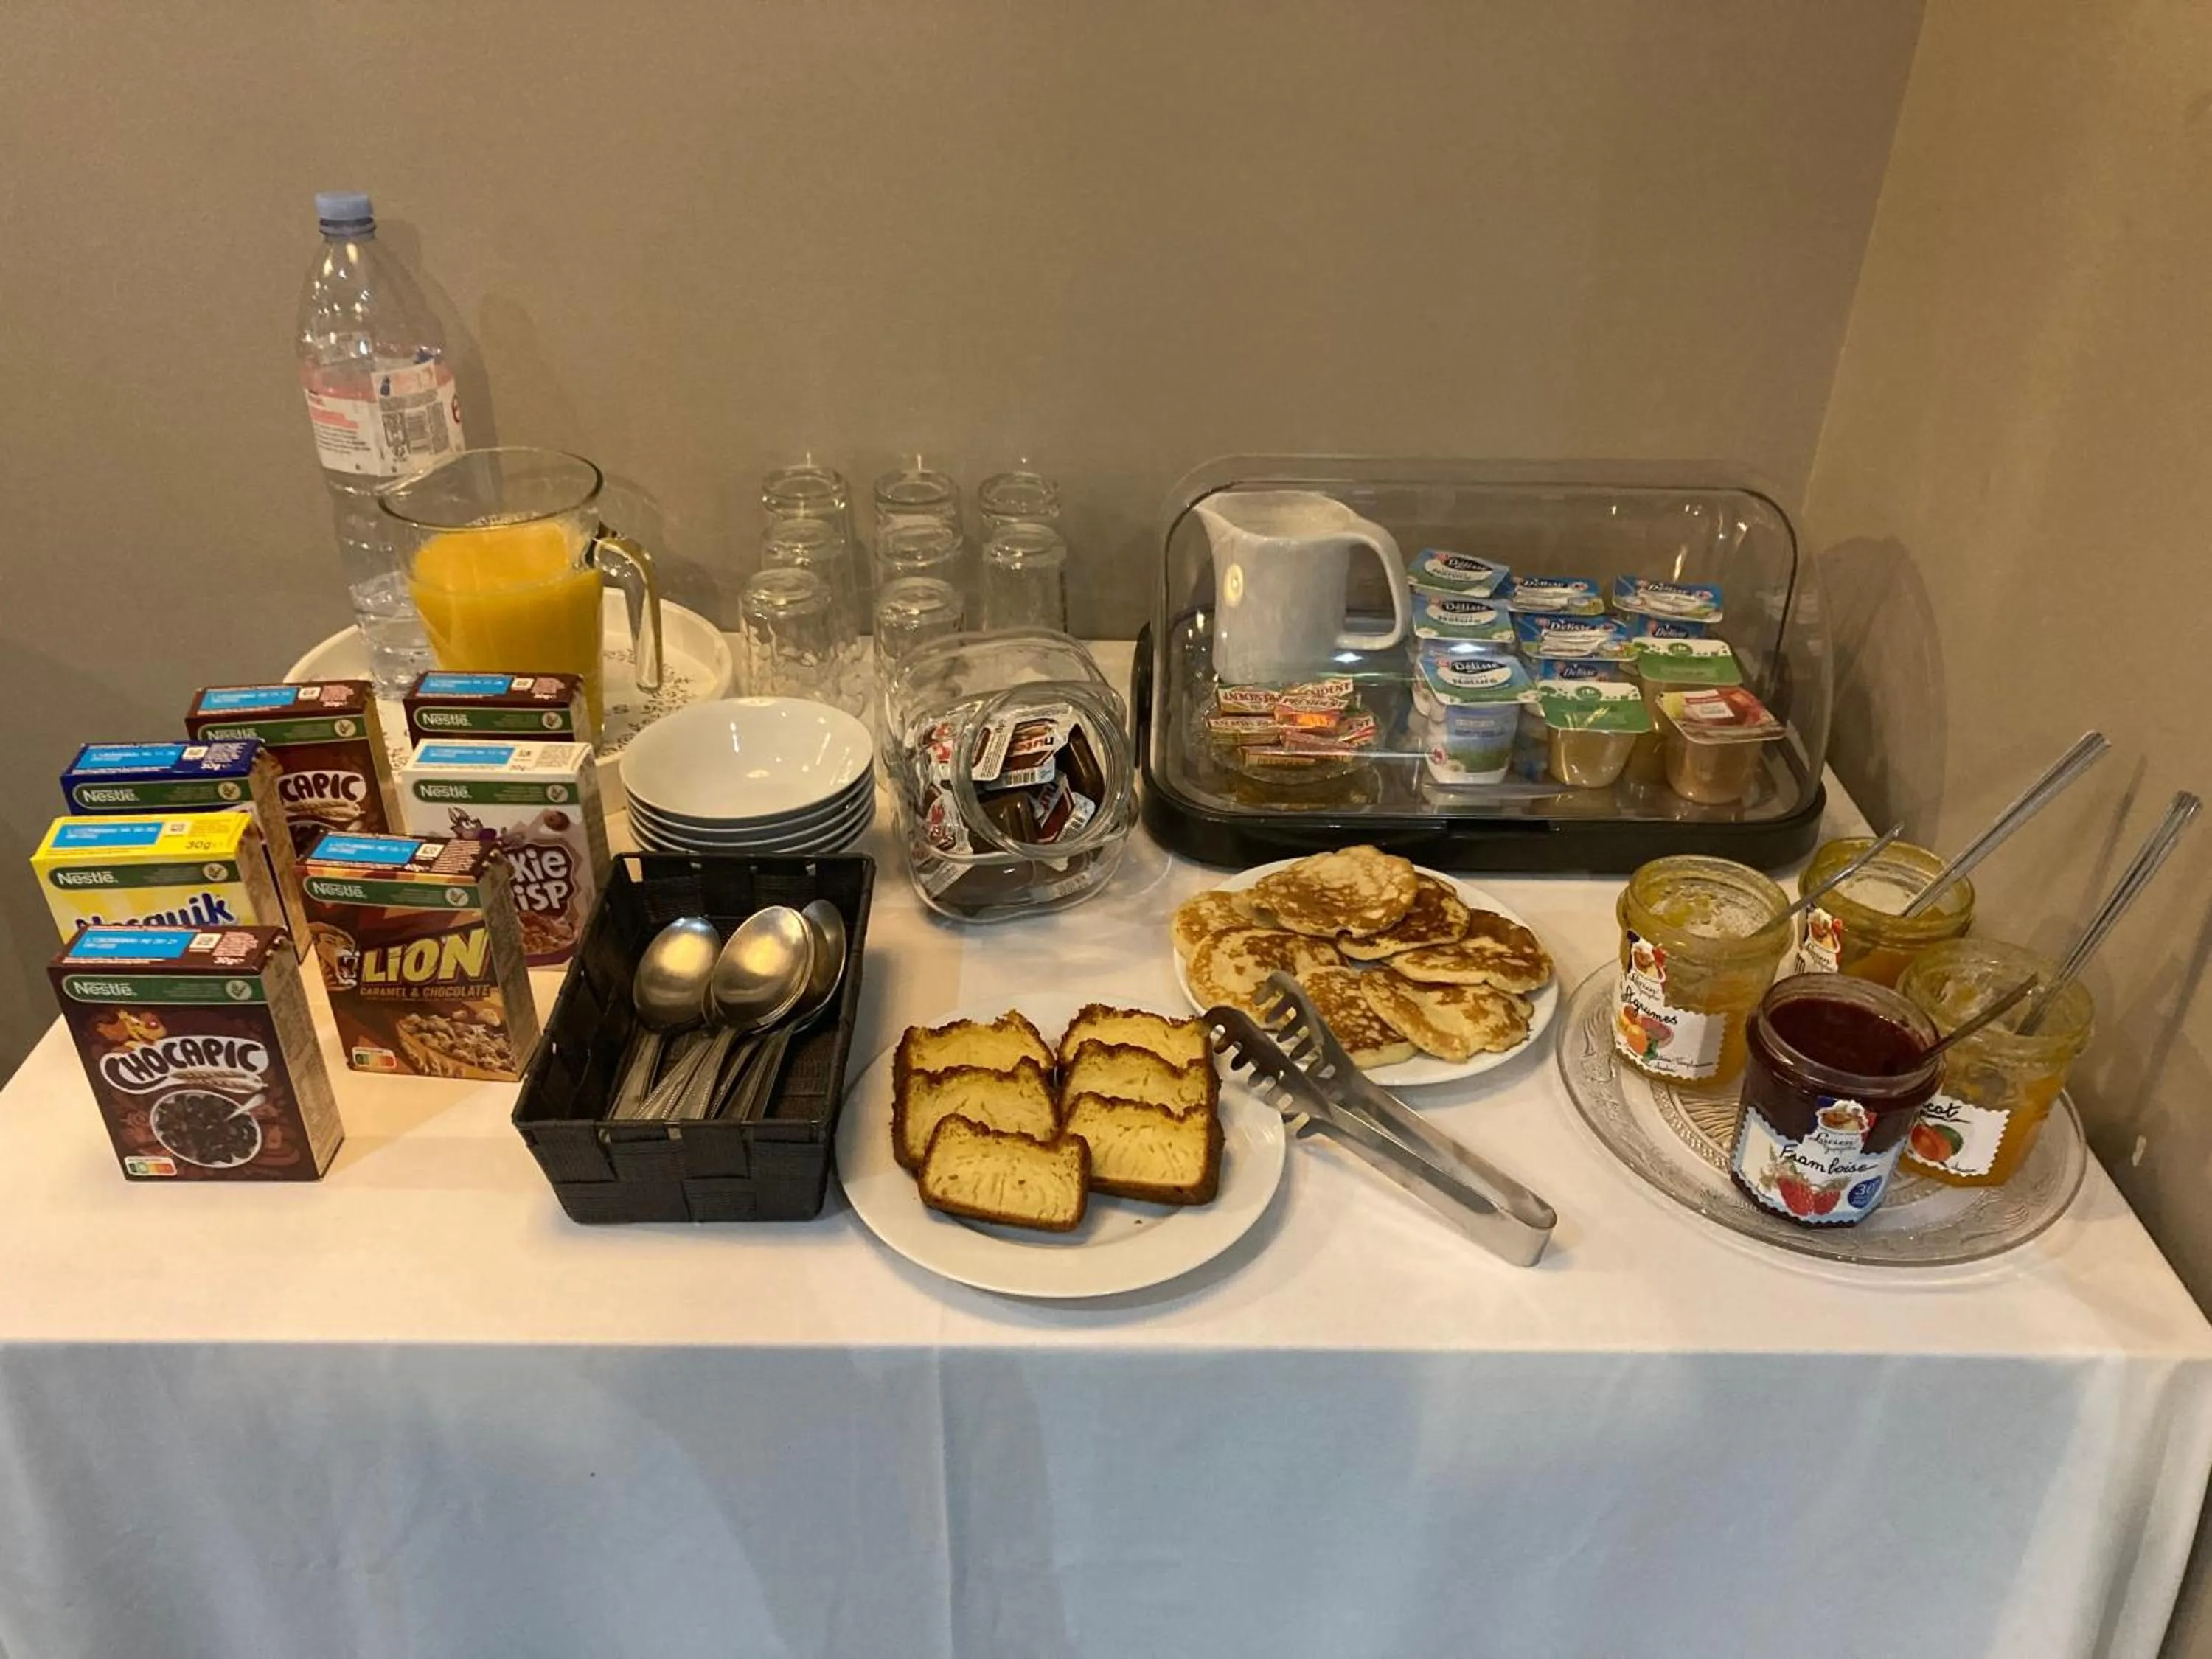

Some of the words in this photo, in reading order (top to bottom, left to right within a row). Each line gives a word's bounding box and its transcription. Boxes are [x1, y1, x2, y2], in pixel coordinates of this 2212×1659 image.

[81, 788, 139, 803] Nestlé
[278, 772, 361, 803] CAPIC
[185, 839, 212, 850] 30g
[56, 871, 118, 886] Nestlé
[312, 882, 366, 899] Nestlé
[72, 980, 137, 998] Nestlé
[359, 986, 406, 996] CARAMEL
[410, 987, 420, 998] &
[422, 985, 492, 998] CHOCOLATE
[104, 1037, 262, 1091] CHOCAPIC
[1922, 1102, 1962, 1119] cot
[1779, 1144, 1879, 1175] Framboise
